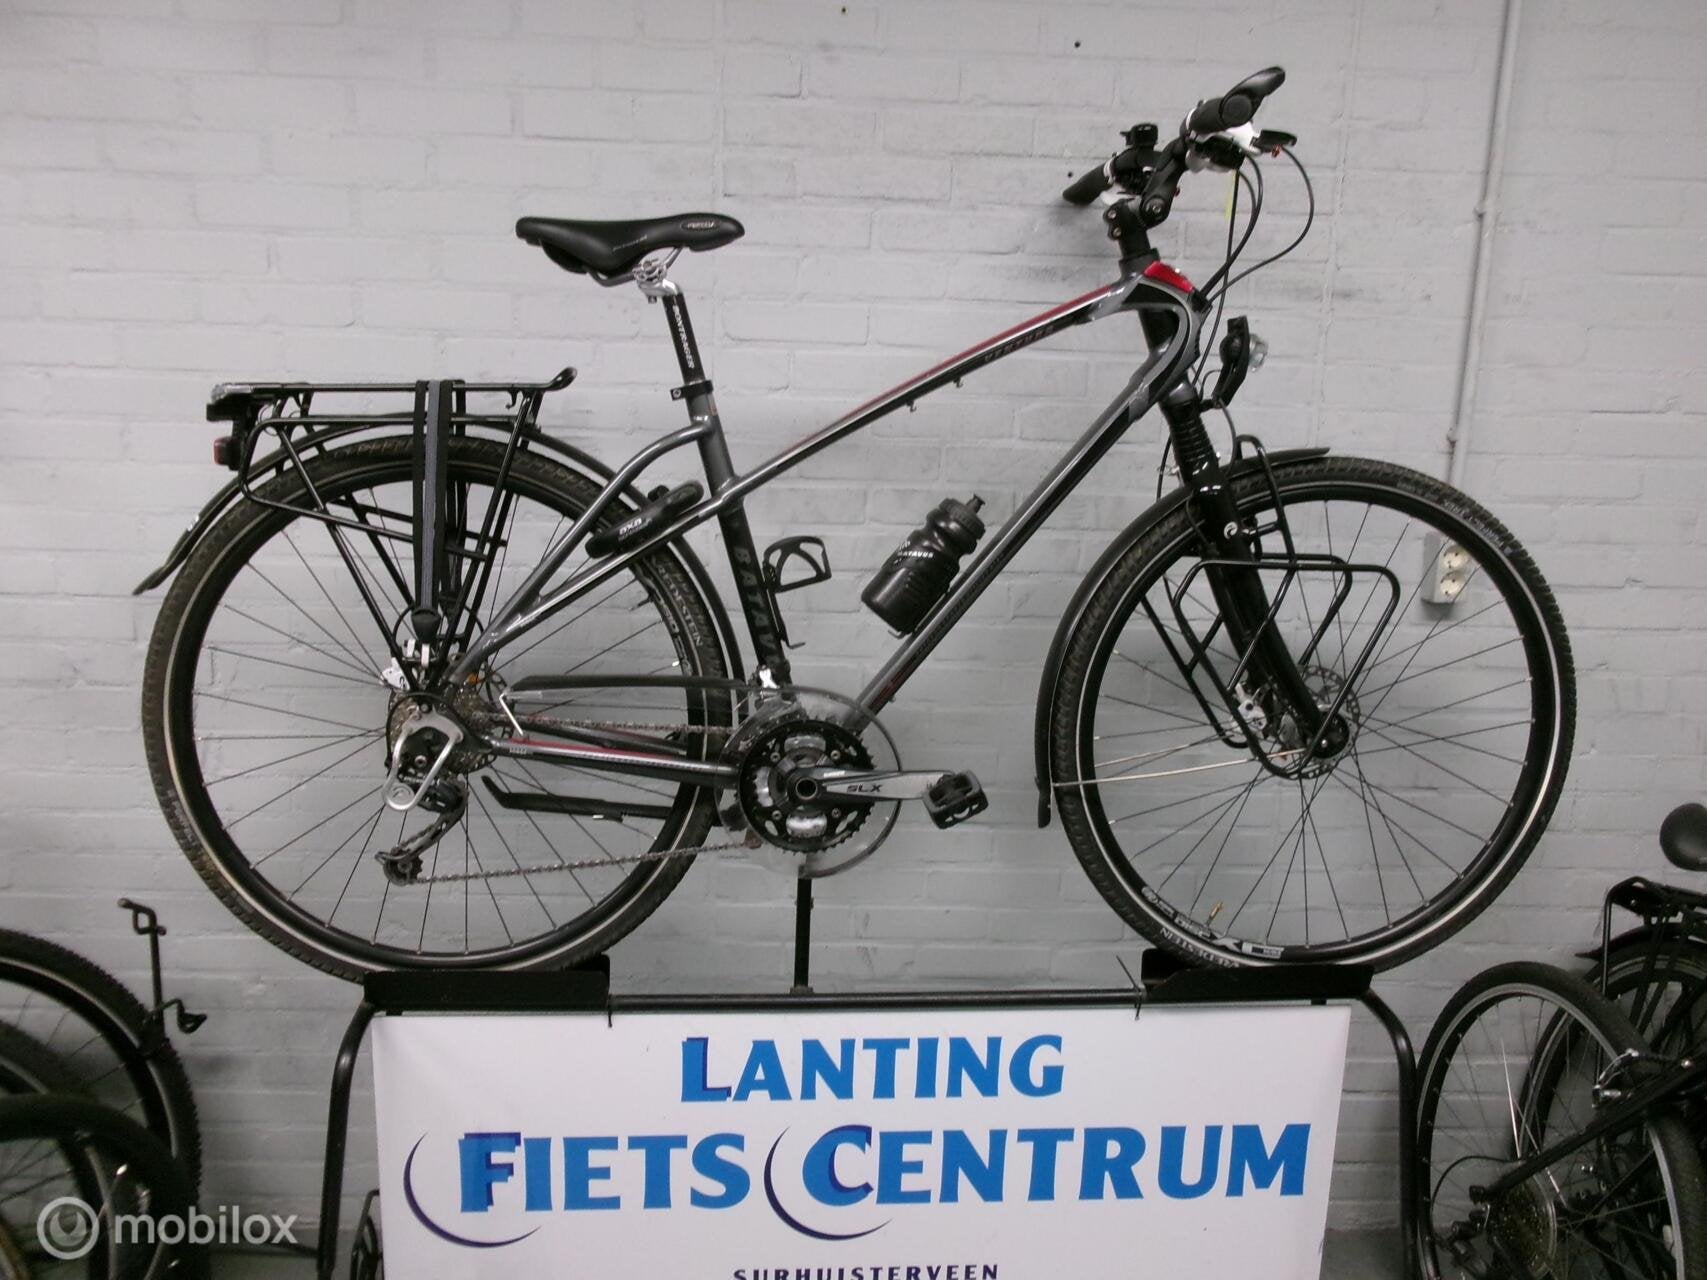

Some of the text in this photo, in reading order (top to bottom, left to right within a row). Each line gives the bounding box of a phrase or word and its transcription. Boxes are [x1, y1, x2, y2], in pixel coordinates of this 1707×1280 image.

[847, 783, 883, 793] SLX
[681, 1034, 1064, 1103] LANTING
[458, 1123, 1312, 1212] FIETS CENTRUM
[732, 1263, 999, 1280] SURHUISTERVEEN
